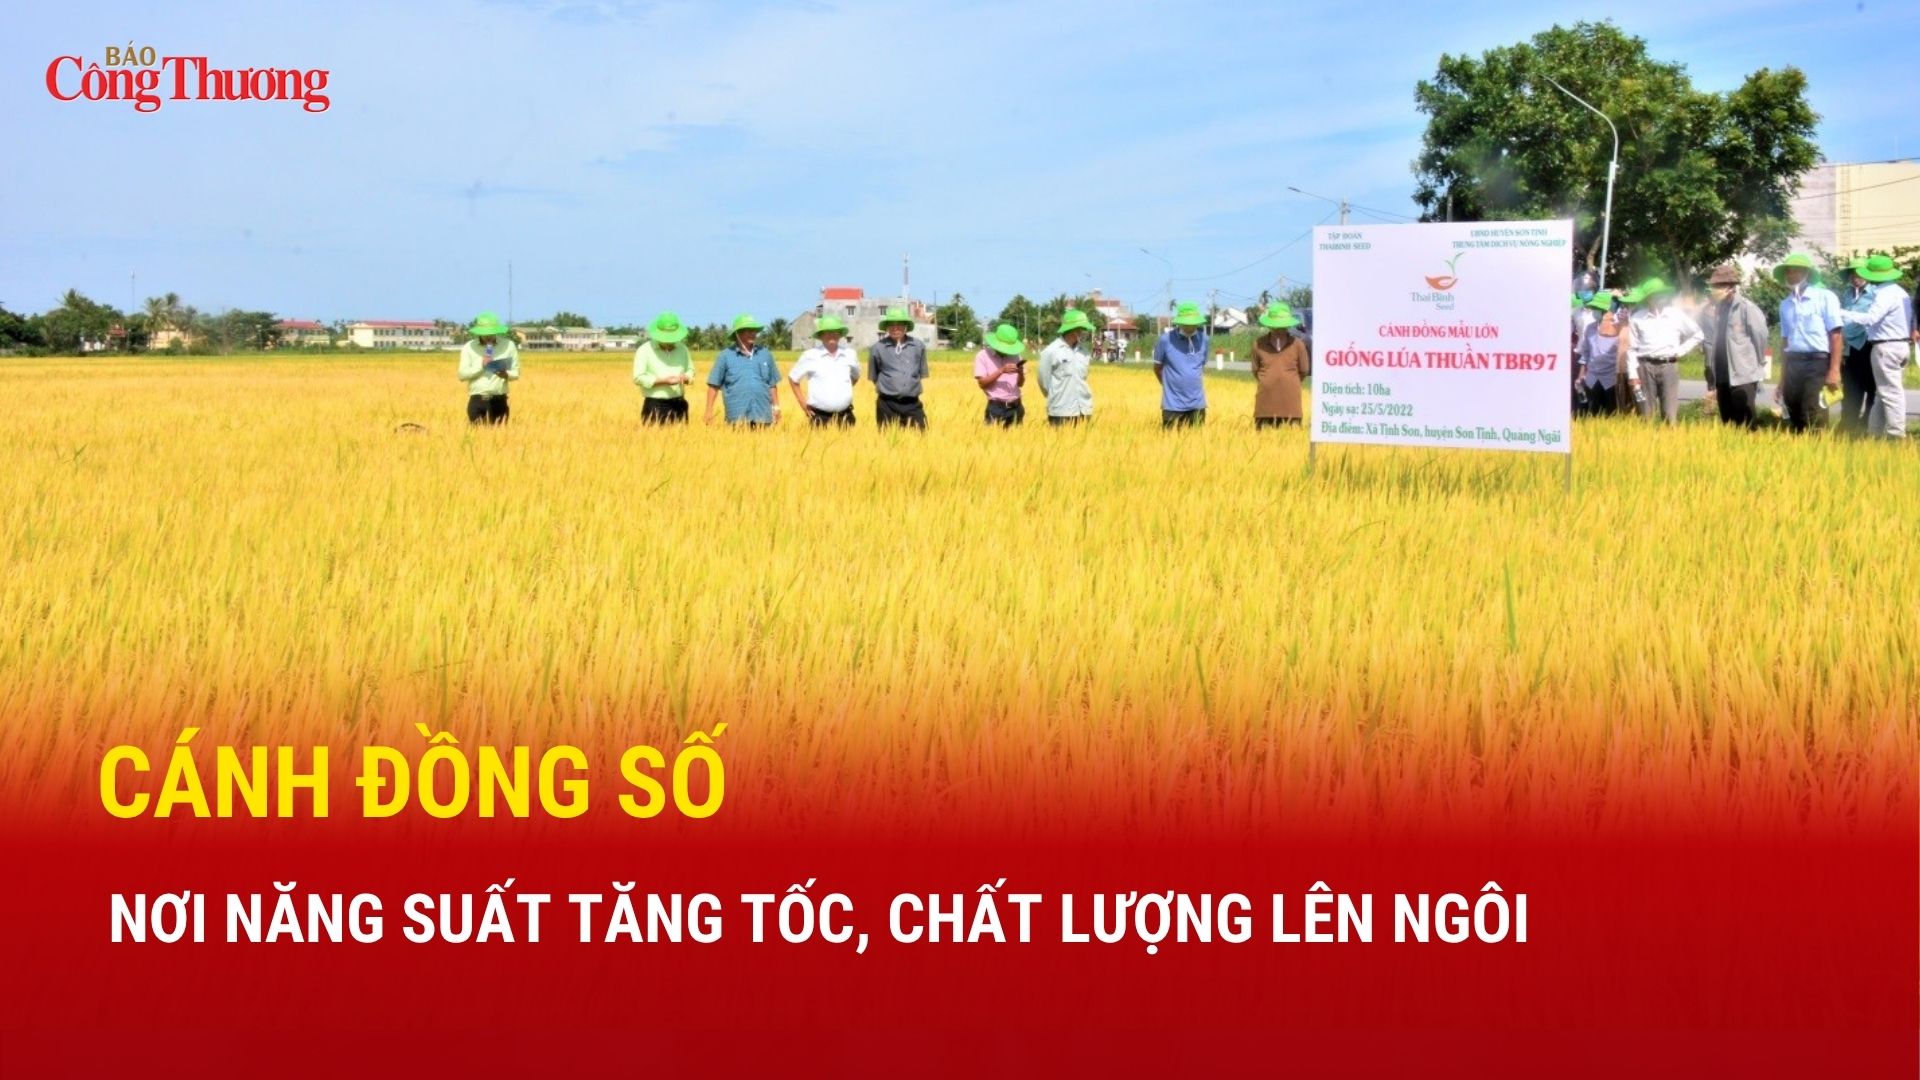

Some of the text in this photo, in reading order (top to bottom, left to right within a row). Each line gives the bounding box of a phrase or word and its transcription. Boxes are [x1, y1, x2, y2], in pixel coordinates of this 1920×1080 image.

[1435, 303, 1455, 311] Seed
[1325, 341, 1558, 371] GIỐNG LÚA THUẦN TBR97
[1367, 383, 1391, 395] 10ha
[1360, 402, 1413, 416] 25/5/2022
